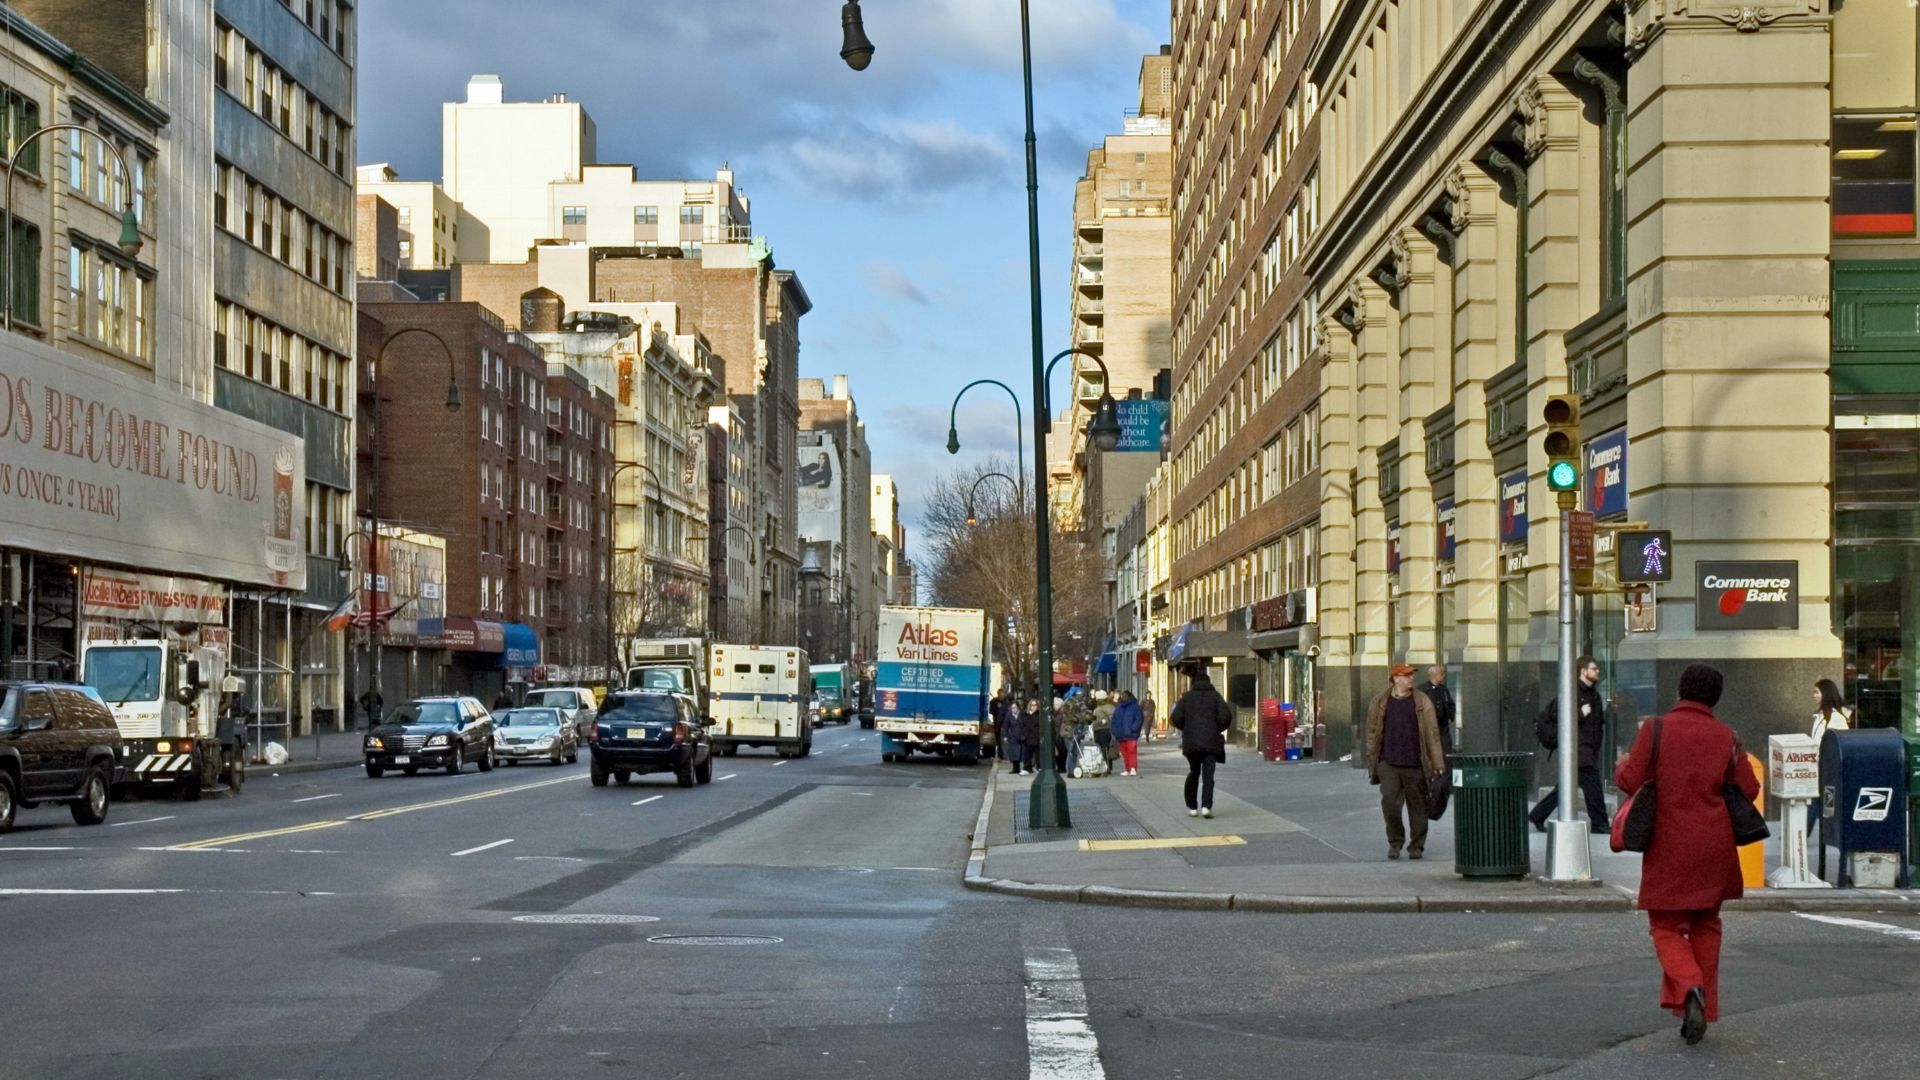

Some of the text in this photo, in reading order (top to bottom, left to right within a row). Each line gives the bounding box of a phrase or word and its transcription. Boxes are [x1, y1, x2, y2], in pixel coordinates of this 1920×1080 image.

[1128, 404, 1148, 415] child
[1117, 415, 1149, 426] hould be
[43, 385, 169, 480] BECOME
[1121, 426, 1145, 436] ithout
[1116, 436, 1151, 447] althcare.
[1590, 445, 1621, 470] Commerce
[1604, 463, 1620, 487] Bank
[17, 467, 63, 506] ONCE
[1503, 481, 1526, 500] Commerce
[1513, 495, 1525, 516] Bank
[1704, 575, 1790, 589] Commerce
[1745, 589, 1788, 602] Bank
[898, 622, 958, 646] Atlas
[896, 647, 958, 661] Van Lines
[1785, 771, 1817, 779] CLASSES
